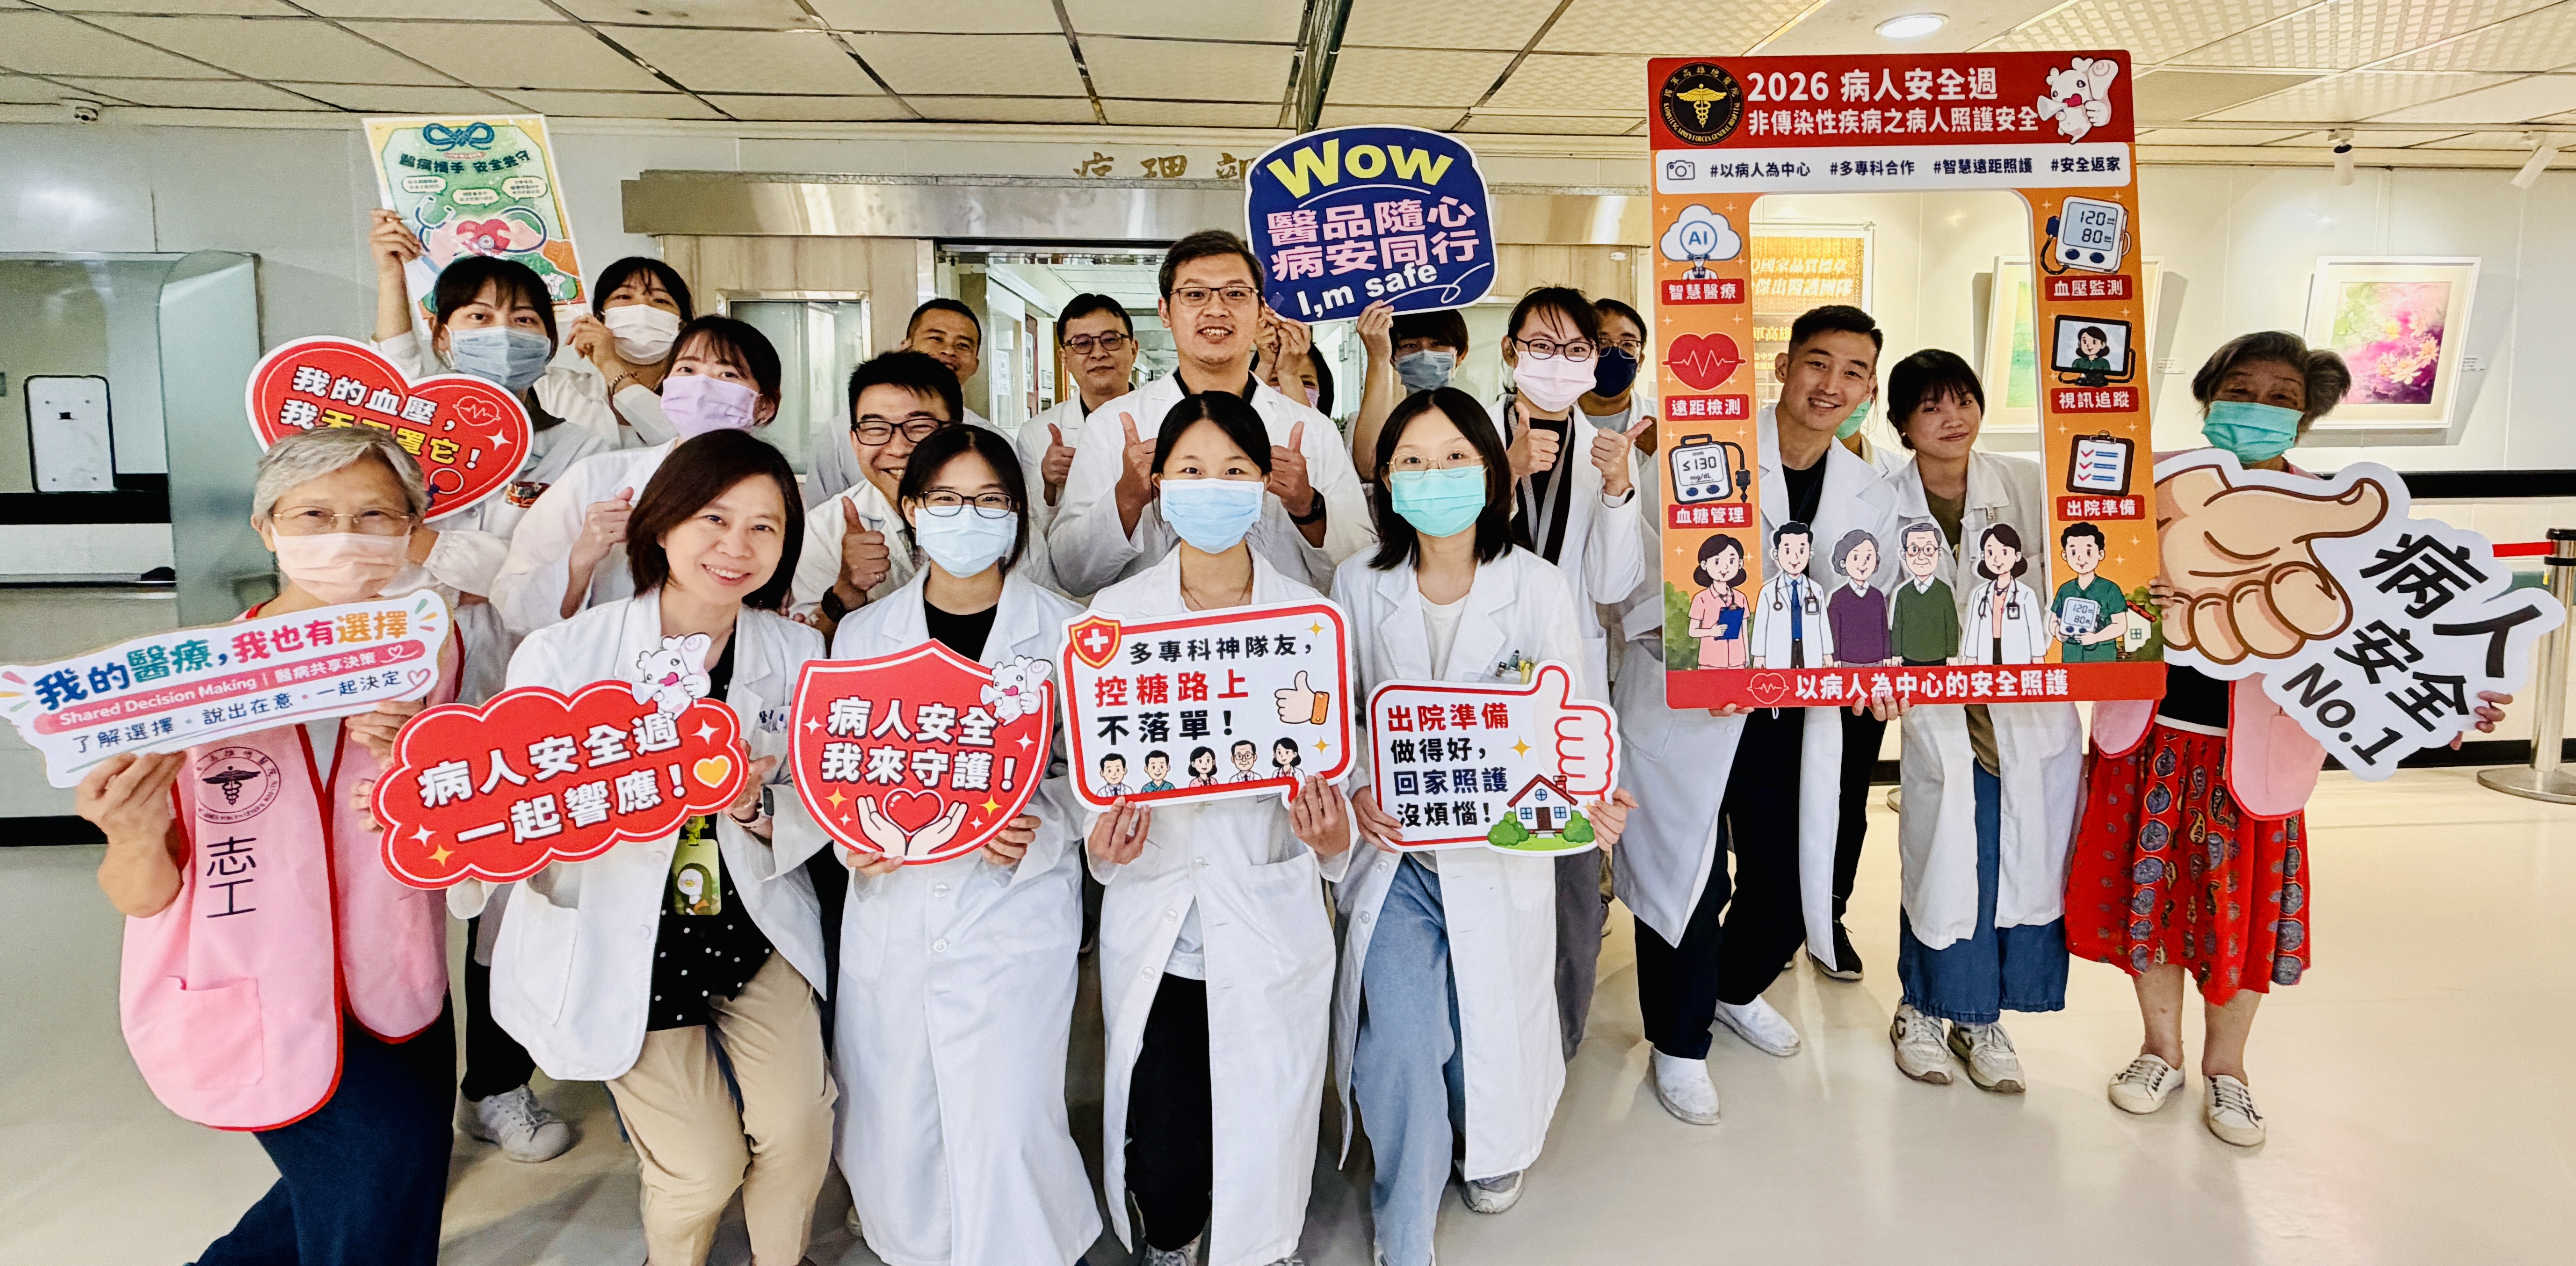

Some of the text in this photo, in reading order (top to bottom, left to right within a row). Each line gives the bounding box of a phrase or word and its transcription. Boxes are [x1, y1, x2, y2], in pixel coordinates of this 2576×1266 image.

[1746, 67, 1997, 103] 2026 病人安全週
[1747, 105, 2039, 137] 非傳染性疾病之病人照護安全
[1710, 156, 2120, 178] #以病人為中心 #多專科合作 #智慧遠距照護 #安全返家
[1267, 196, 1476, 247] 醫品隨心
[2080, 211, 2106, 226] 120
[1688, 230, 1708, 246] AI
[2082, 228, 2103, 244] 80
[1271, 228, 1480, 282] 病安同行
[1367, 261, 1438, 298] safe
[1668, 283, 1737, 300] 智慧醫療
[2054, 279, 2124, 297] 血壓監測
[293, 366, 456, 431] 我的血壓，
[1671, 398, 1741, 416] 遠距檢測
[2059, 391, 2130, 409] 視訊追蹤
[1676, 506, 1744, 524] 血糖管理
[2067, 499, 2136, 517] 出院準備
[2073, 604, 2088, 614] 120
[2074, 615, 2086, 624] 80
[2359, 533, 2542, 678] 病人
[33, 610, 408, 711] 我的醫療，我也有選擇
[1130, 633, 1312, 665] 多專科神隊友，
[276, 652, 376, 684] 醫病共享決策
[2334, 619, 2469, 733] 安全
[59, 676, 257, 726] Shared Decision Making
[1094, 668, 1249, 708] 控糖路上
[1795, 669, 2069, 701] 以病人為中心的安全照護
[826, 696, 998, 747] 病人安全
[1097, 710, 1234, 746] 不落單！
[1387, 702, 1509, 732] 出院準備
[2282, 662, 2404, 766] No.1
[418, 711, 681, 808] 病人安全週
[822, 741, 1017, 792] 我來守護！
[1390, 737, 1486, 765] 做得好，
[1394, 767, 1509, 796] 回家照護
[456, 764, 687, 844] 一起響應！
[1396, 800, 1491, 828] 沒煩惱！
[207, 837, 256, 918] 志工
